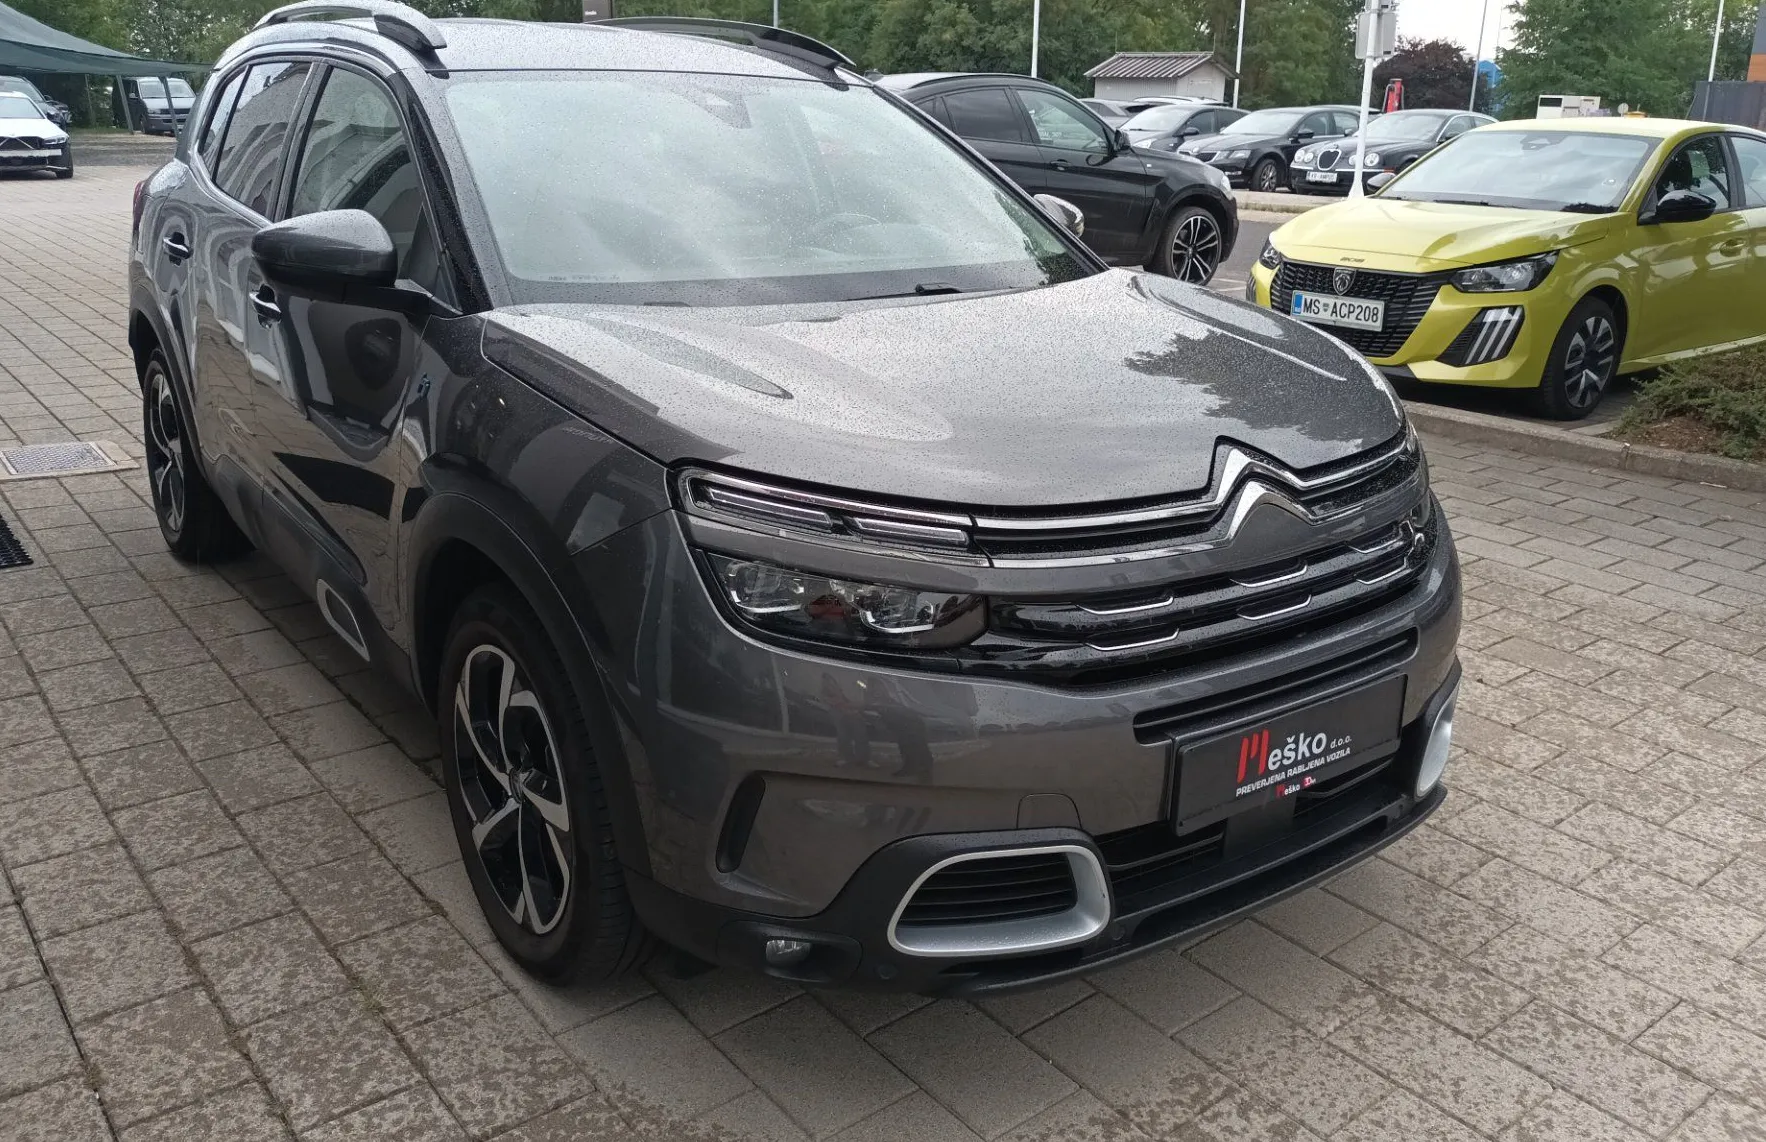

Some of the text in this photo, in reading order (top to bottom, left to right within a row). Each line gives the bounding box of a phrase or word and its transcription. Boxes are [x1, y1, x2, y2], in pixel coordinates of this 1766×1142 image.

[1303, 298, 1379, 323] MS ACP208
[1236, 772, 1286, 797] PREVERJENA
[1287, 757, 1325, 777] RABLJENA
[1326, 747, 1351, 763] VOZILA
[1237, 729, 1352, 784] Meško d.o.o.
